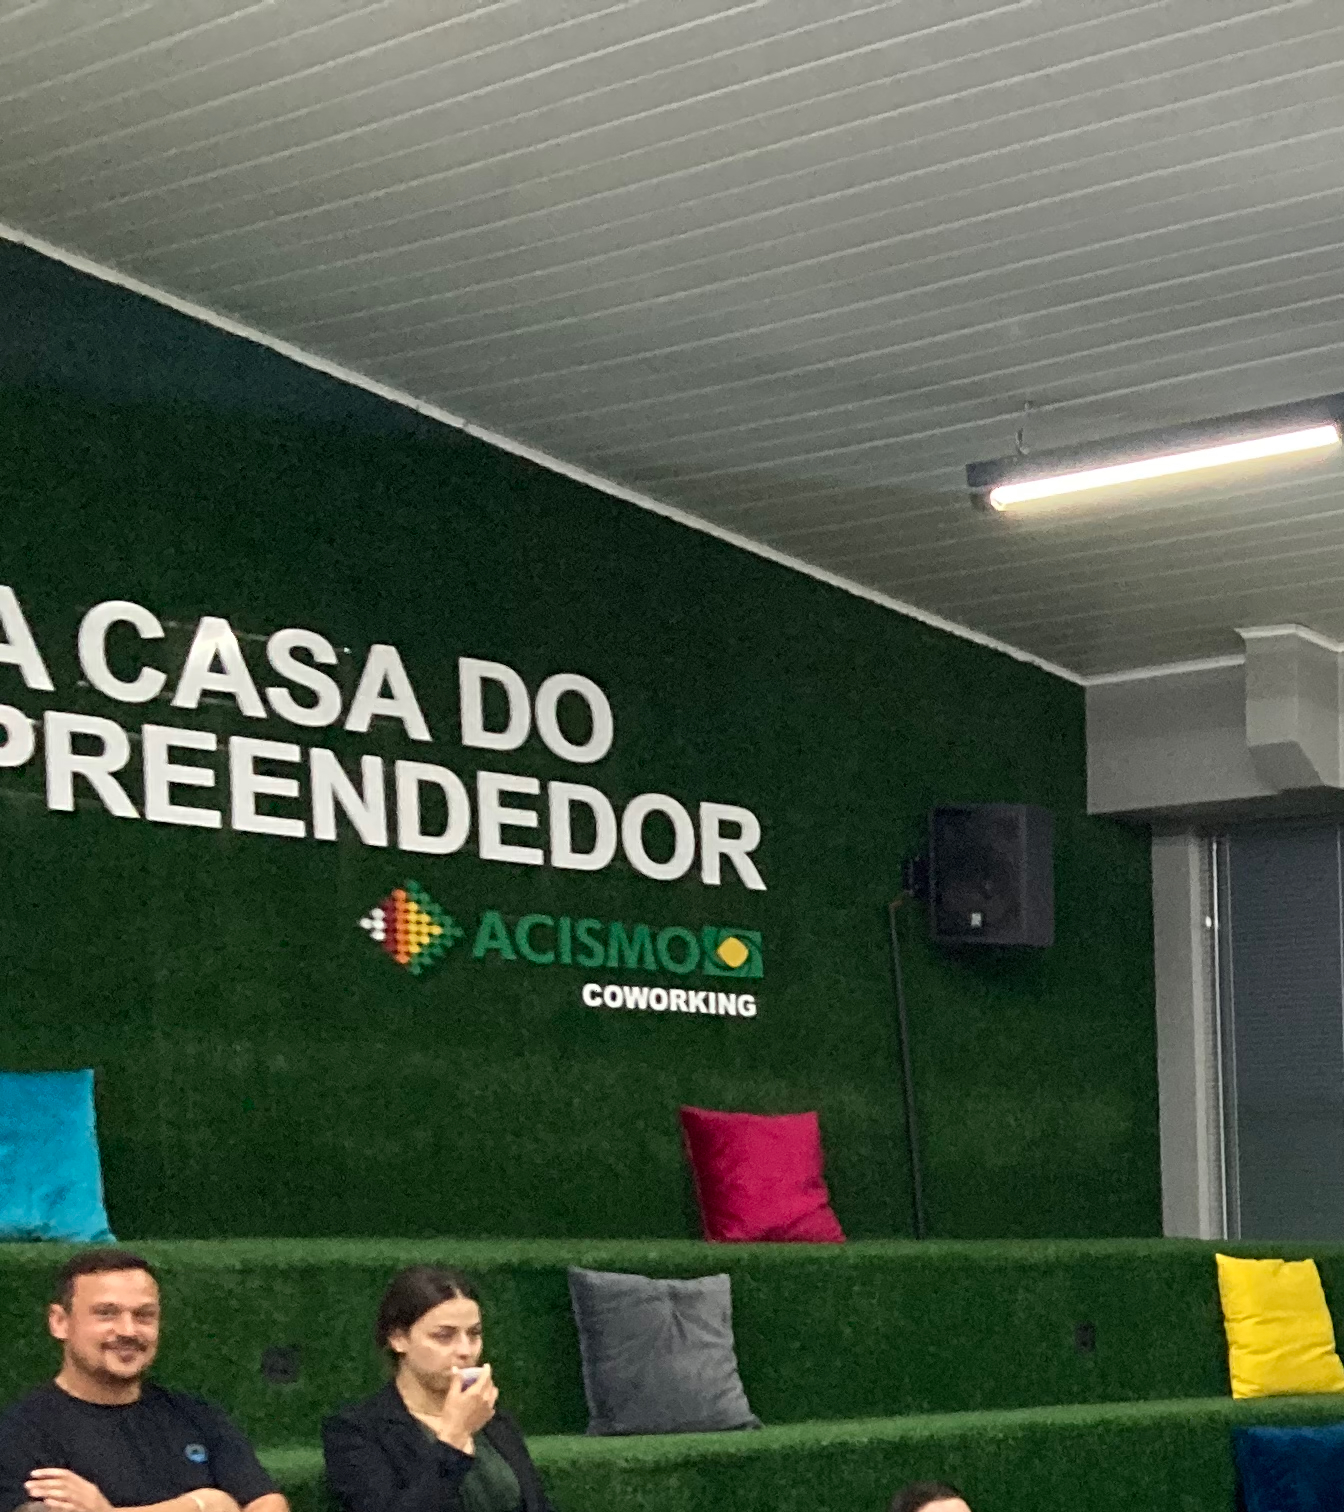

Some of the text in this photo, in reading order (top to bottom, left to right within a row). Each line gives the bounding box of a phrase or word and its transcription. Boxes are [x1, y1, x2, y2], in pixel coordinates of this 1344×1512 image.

[77, 599, 431, 742] CASA
[458, 656, 615, 764] DO
[472, 909, 701, 975] ACISMO
[581, 982, 758, 1018] COWORKING
